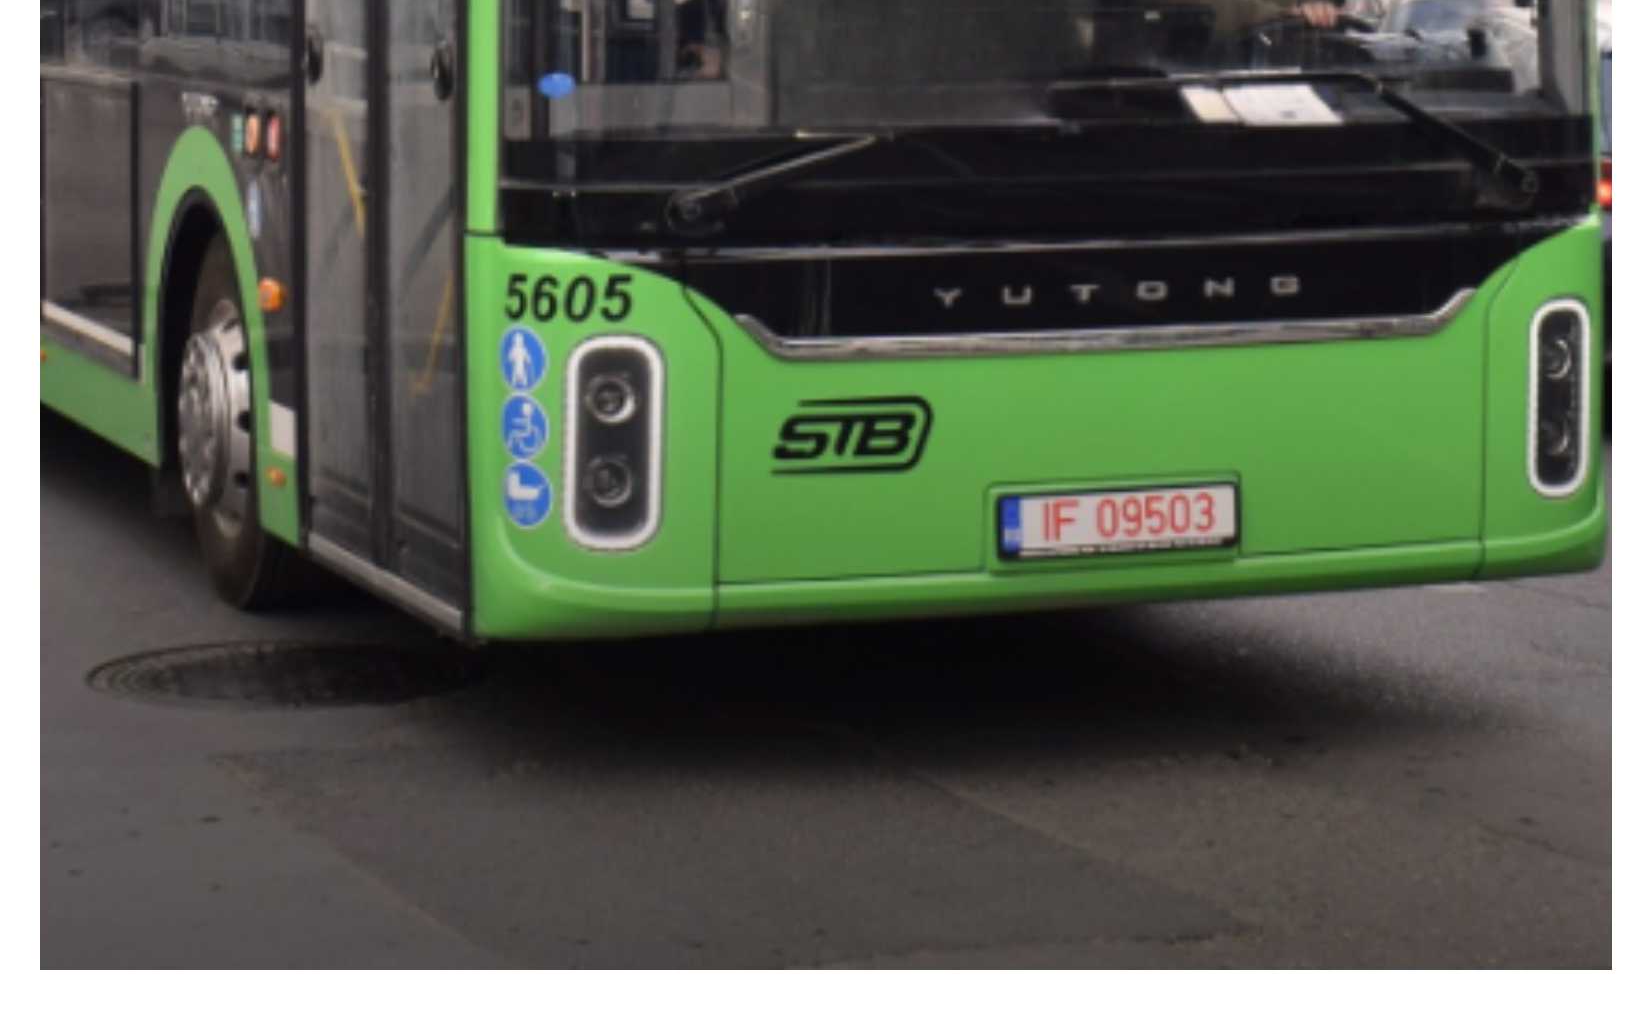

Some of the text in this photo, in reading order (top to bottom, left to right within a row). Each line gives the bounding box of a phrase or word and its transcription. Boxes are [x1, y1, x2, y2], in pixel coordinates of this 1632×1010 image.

[504, 273, 634, 323] 5605
[933, 275, 1299, 309] YUTONG
[772, 412, 916, 460] STB
[1041, 491, 1217, 542] IF 09503
